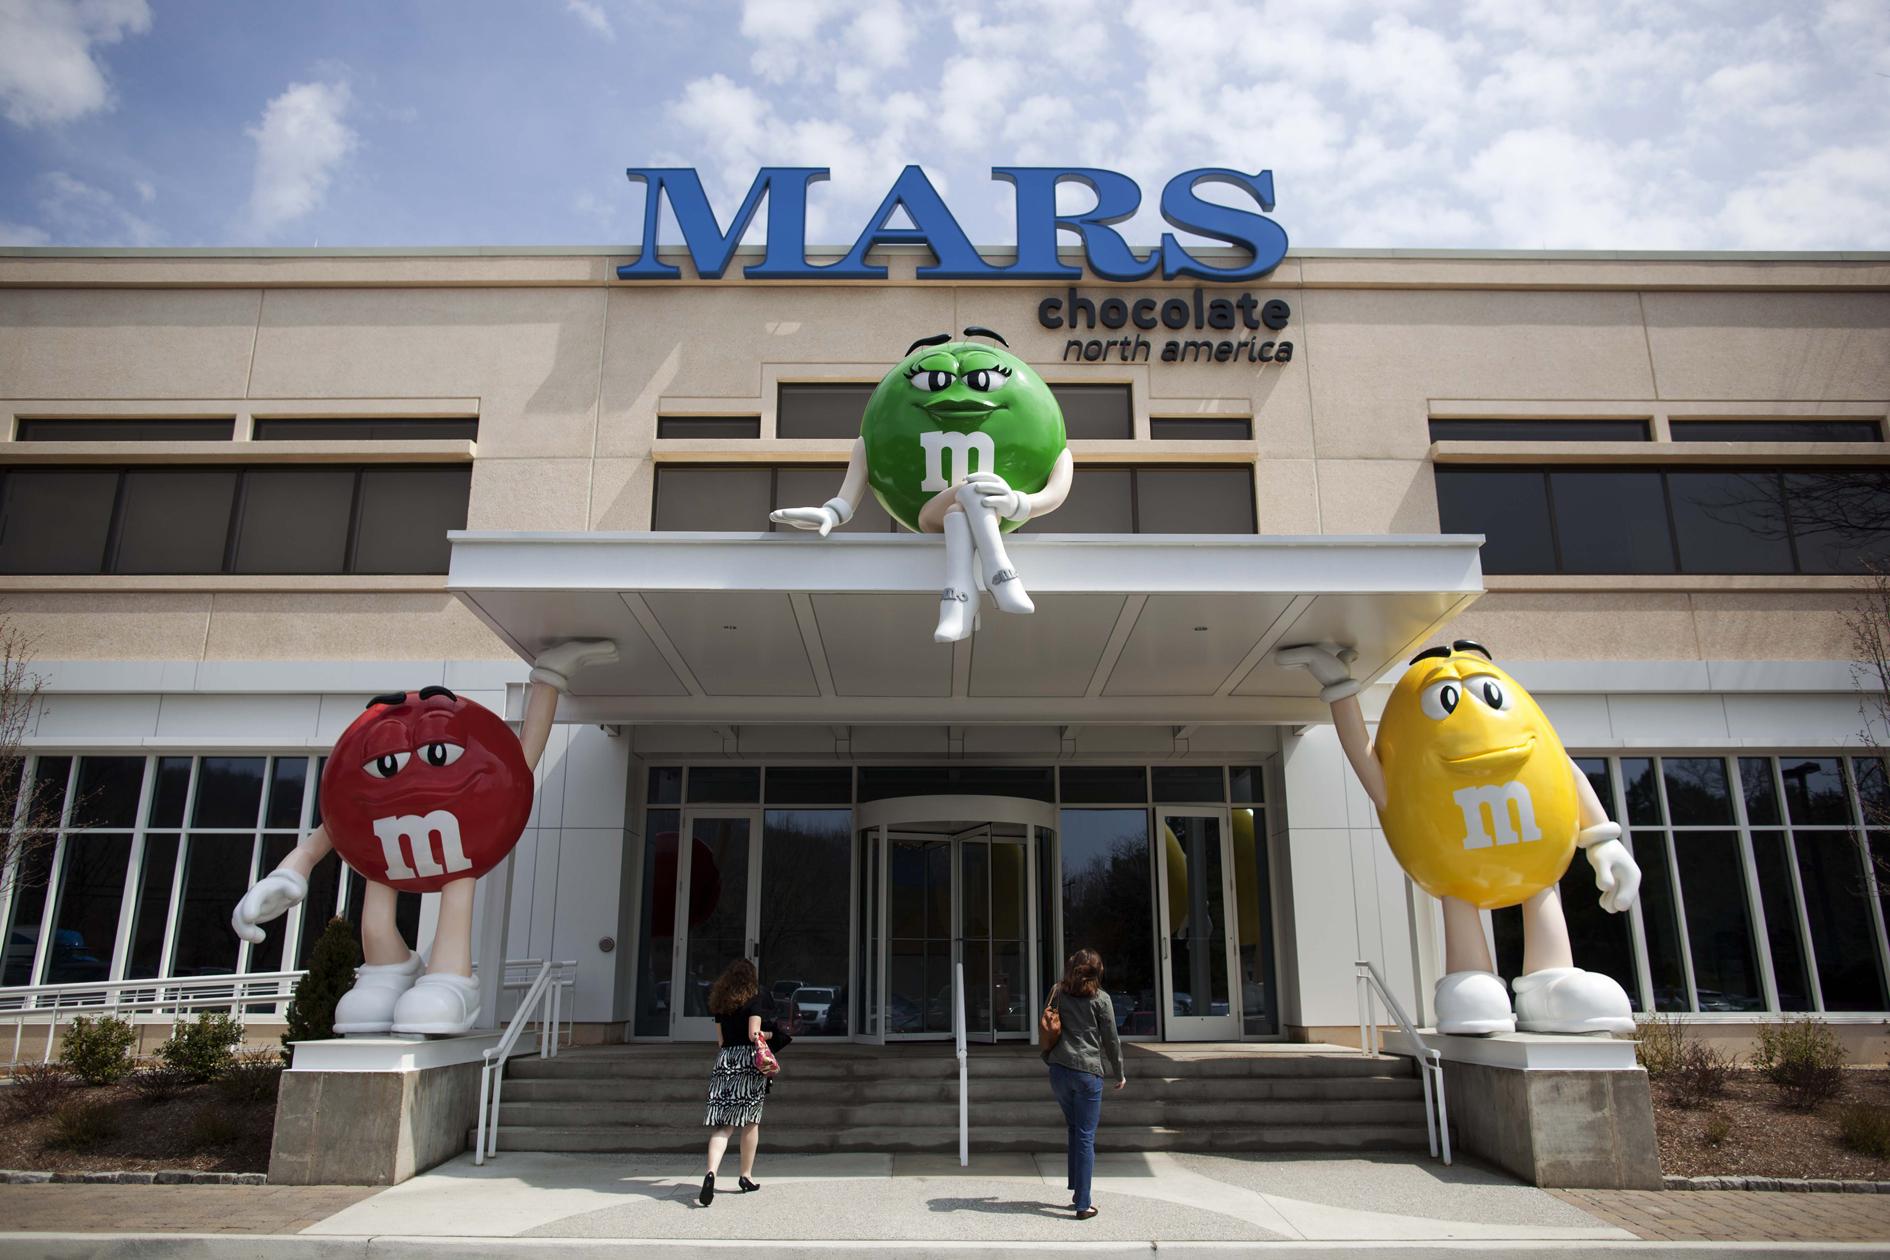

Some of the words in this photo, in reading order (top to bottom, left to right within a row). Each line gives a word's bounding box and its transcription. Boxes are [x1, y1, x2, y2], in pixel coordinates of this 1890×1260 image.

[617, 164, 1289, 281] MARS
[1038, 288, 1291, 330] chocolate
[1064, 334, 1150, 362] north
[1160, 335, 1294, 363] america
[919, 430, 995, 492] m
[372, 810, 472, 880] m
[1453, 781, 1541, 850] m
